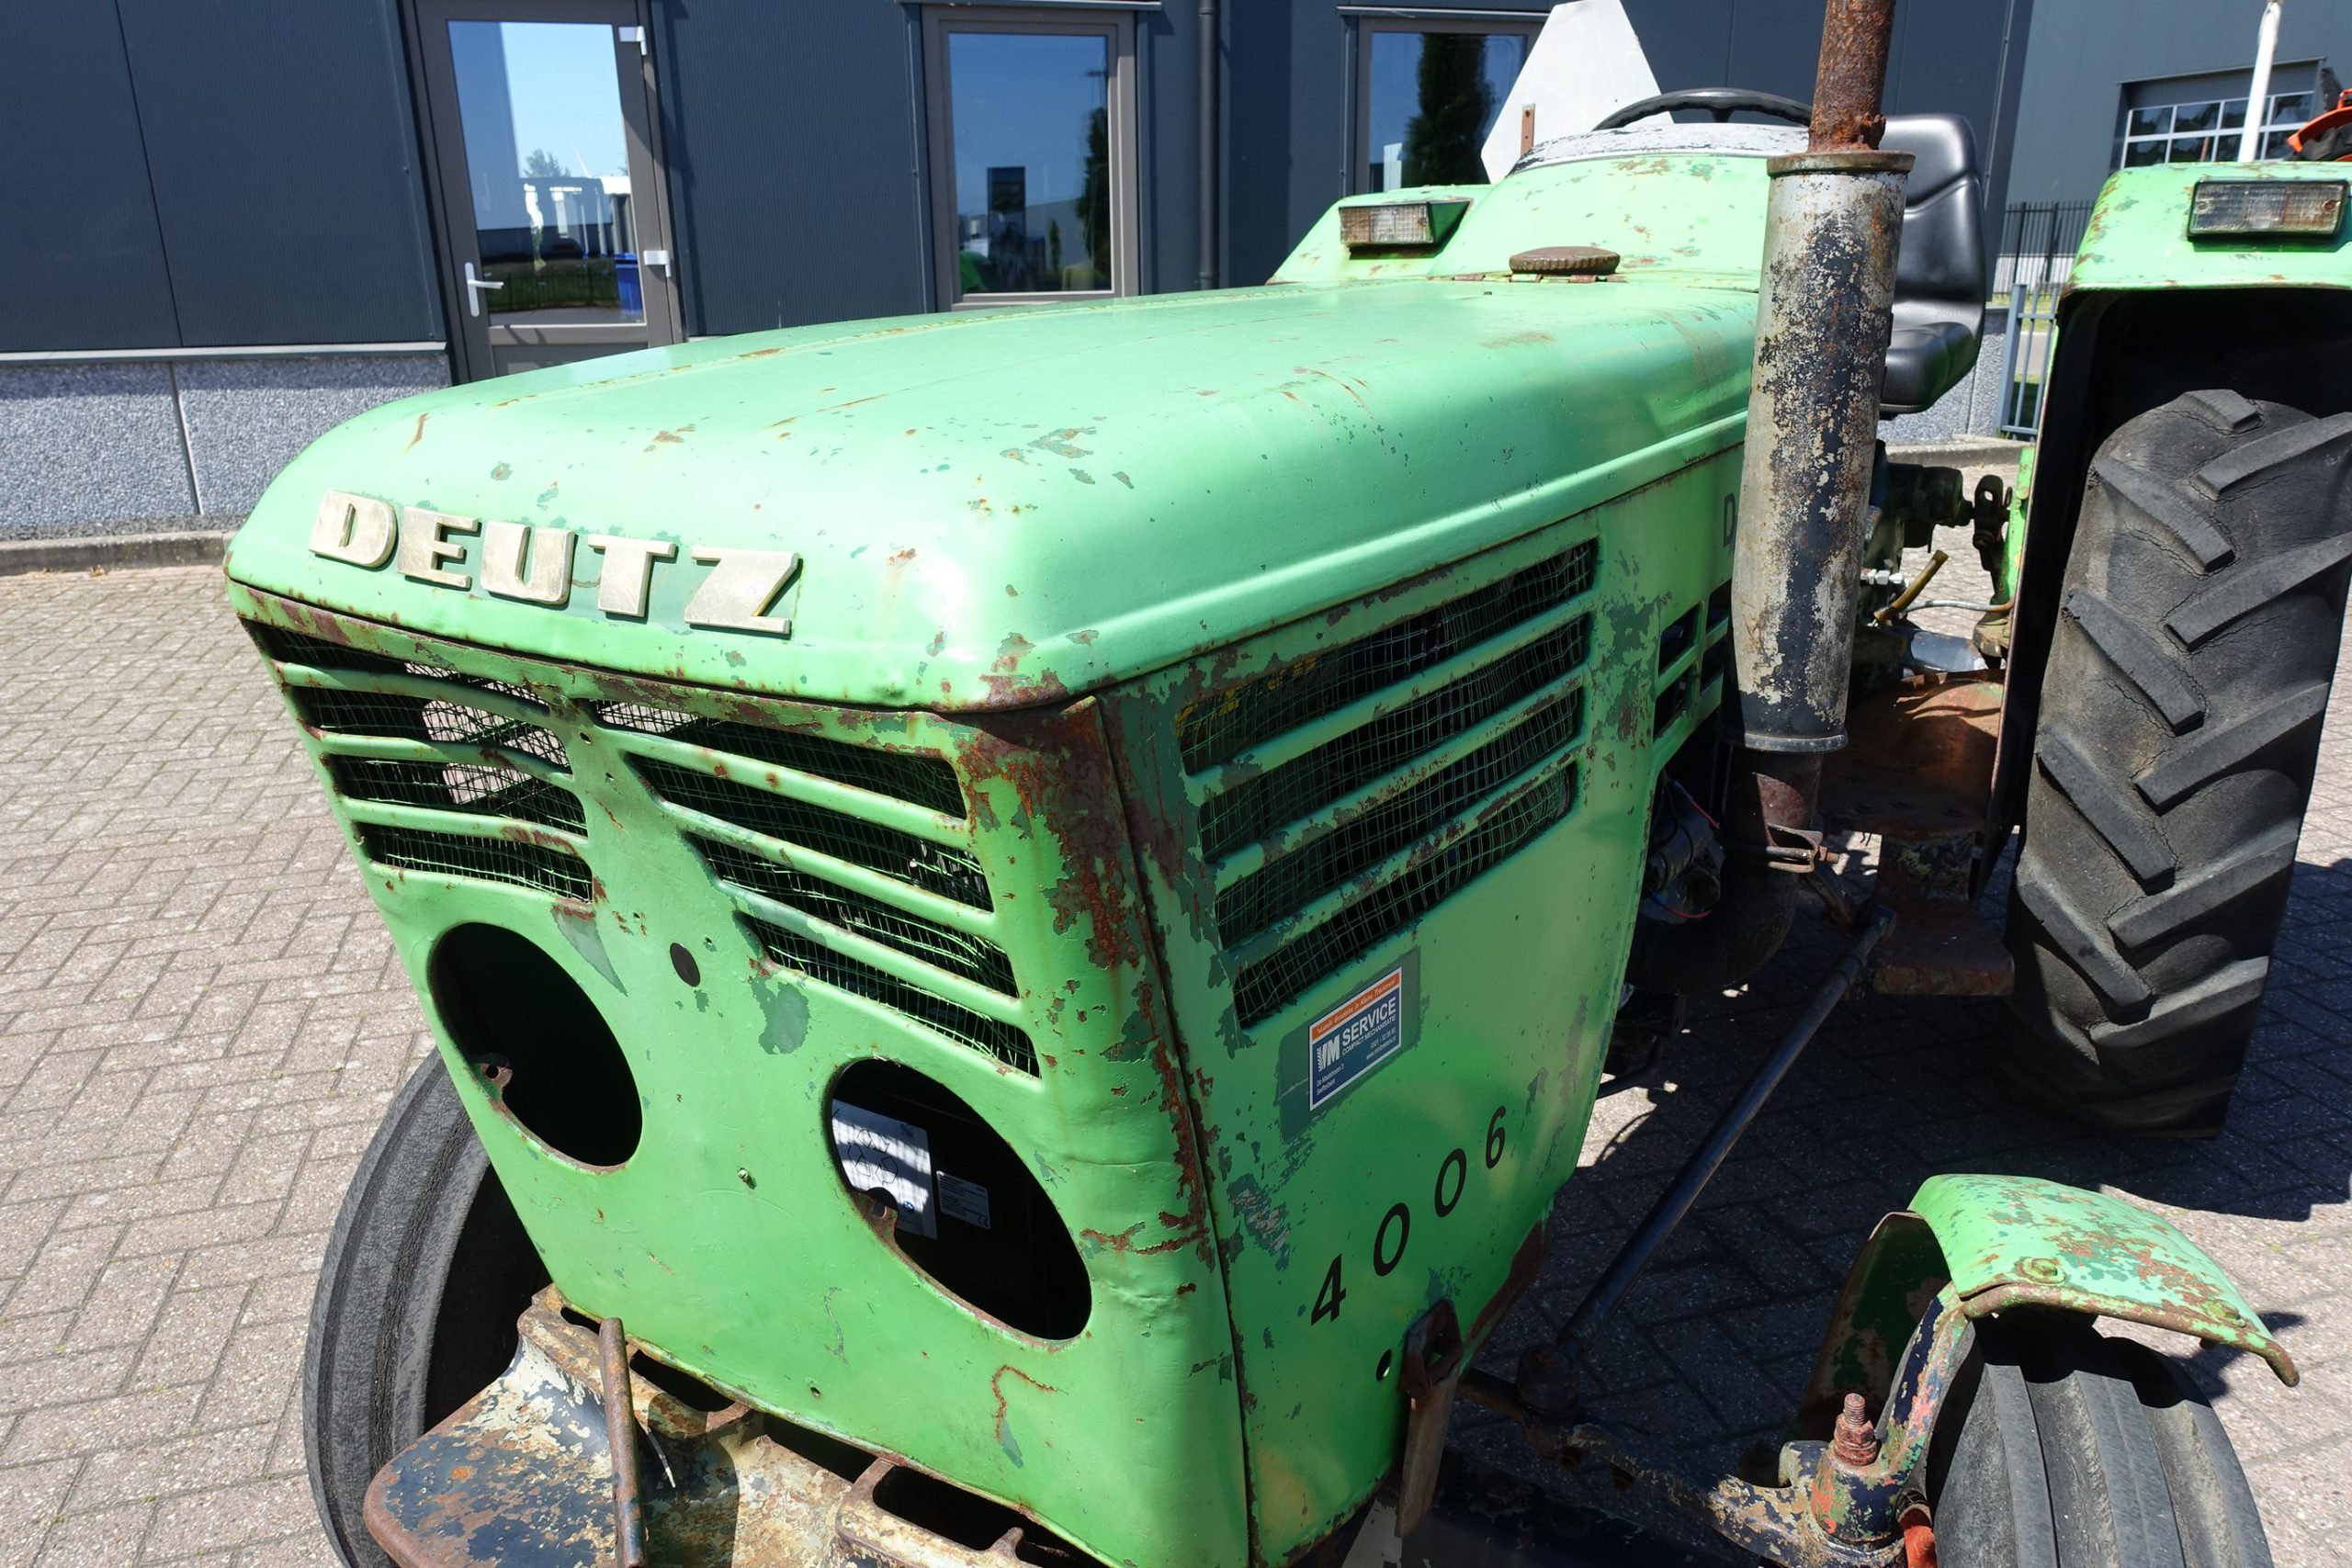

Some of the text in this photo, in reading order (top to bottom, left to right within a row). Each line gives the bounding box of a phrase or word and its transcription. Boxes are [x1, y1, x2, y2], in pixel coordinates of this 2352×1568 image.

[310, 491, 800, 636] DEUTZ
[1341, 1035, 1364, 1056] COMPACT
[1342, 997, 1396, 1046] SERVICE
[1311, 1106, 1507, 1326] 4006
